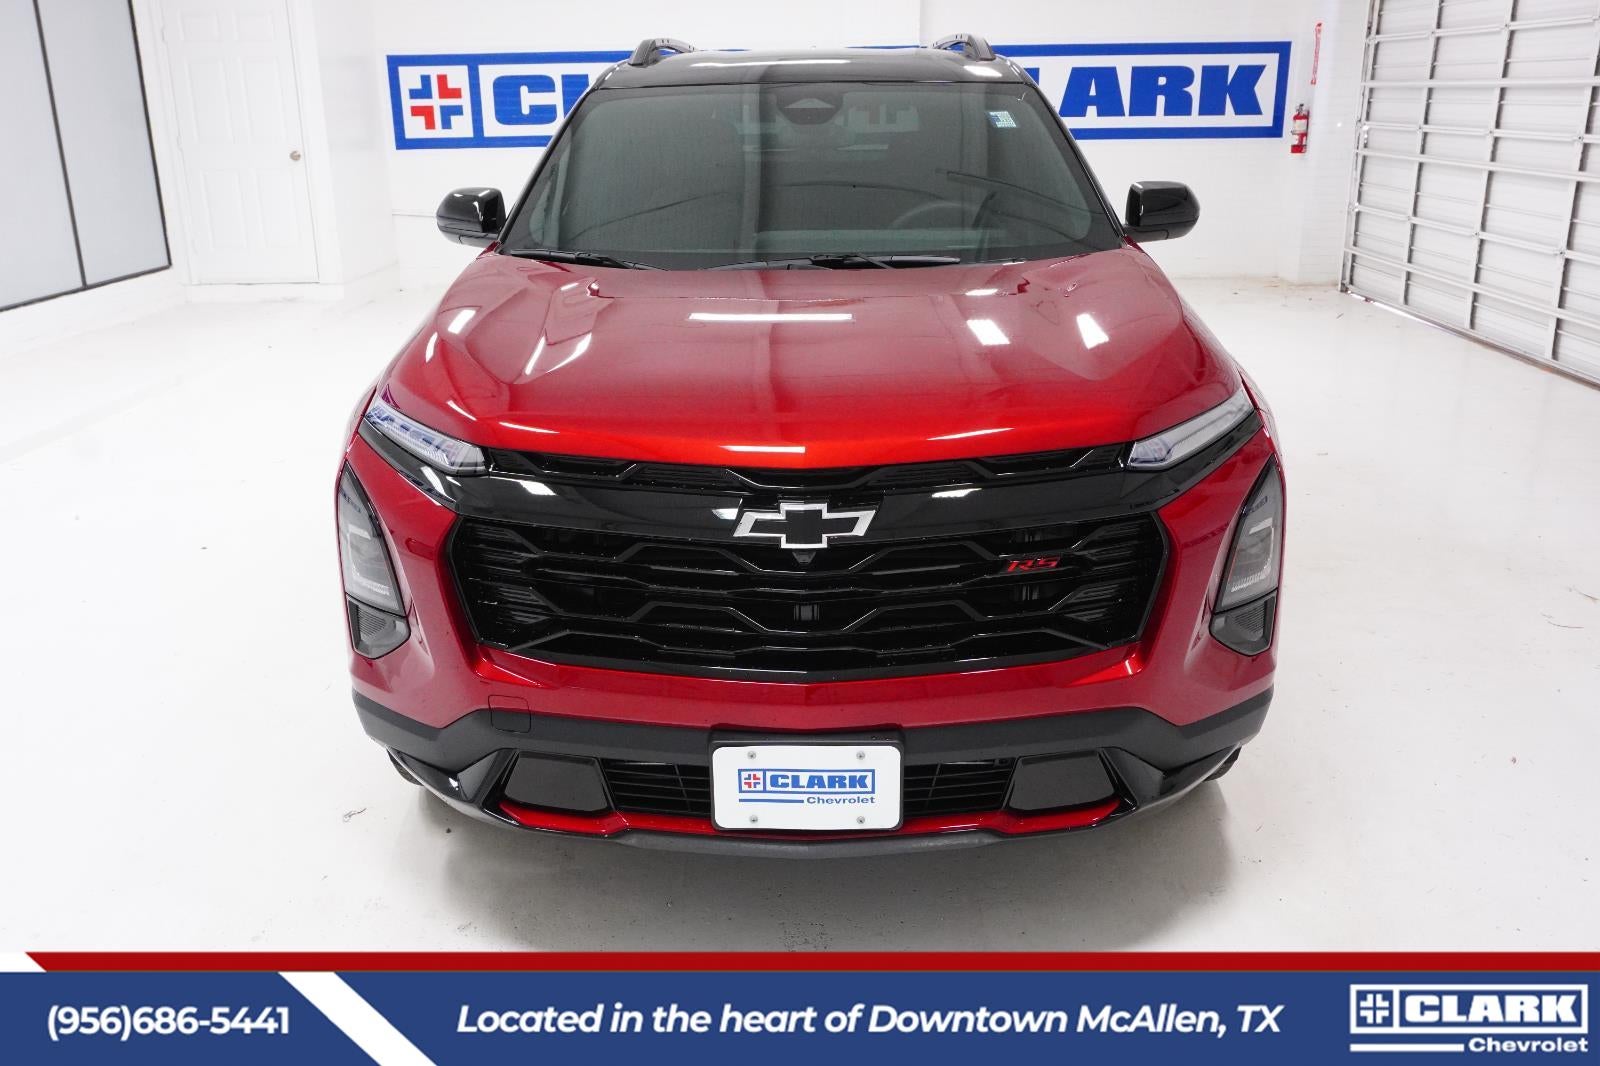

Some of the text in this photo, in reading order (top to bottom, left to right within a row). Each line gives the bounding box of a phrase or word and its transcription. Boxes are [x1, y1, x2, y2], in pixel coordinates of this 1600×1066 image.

[1007, 558, 1061, 572] RS
[769, 774, 868, 789] CLARK
[806, 796, 876, 805] Chevrolet
